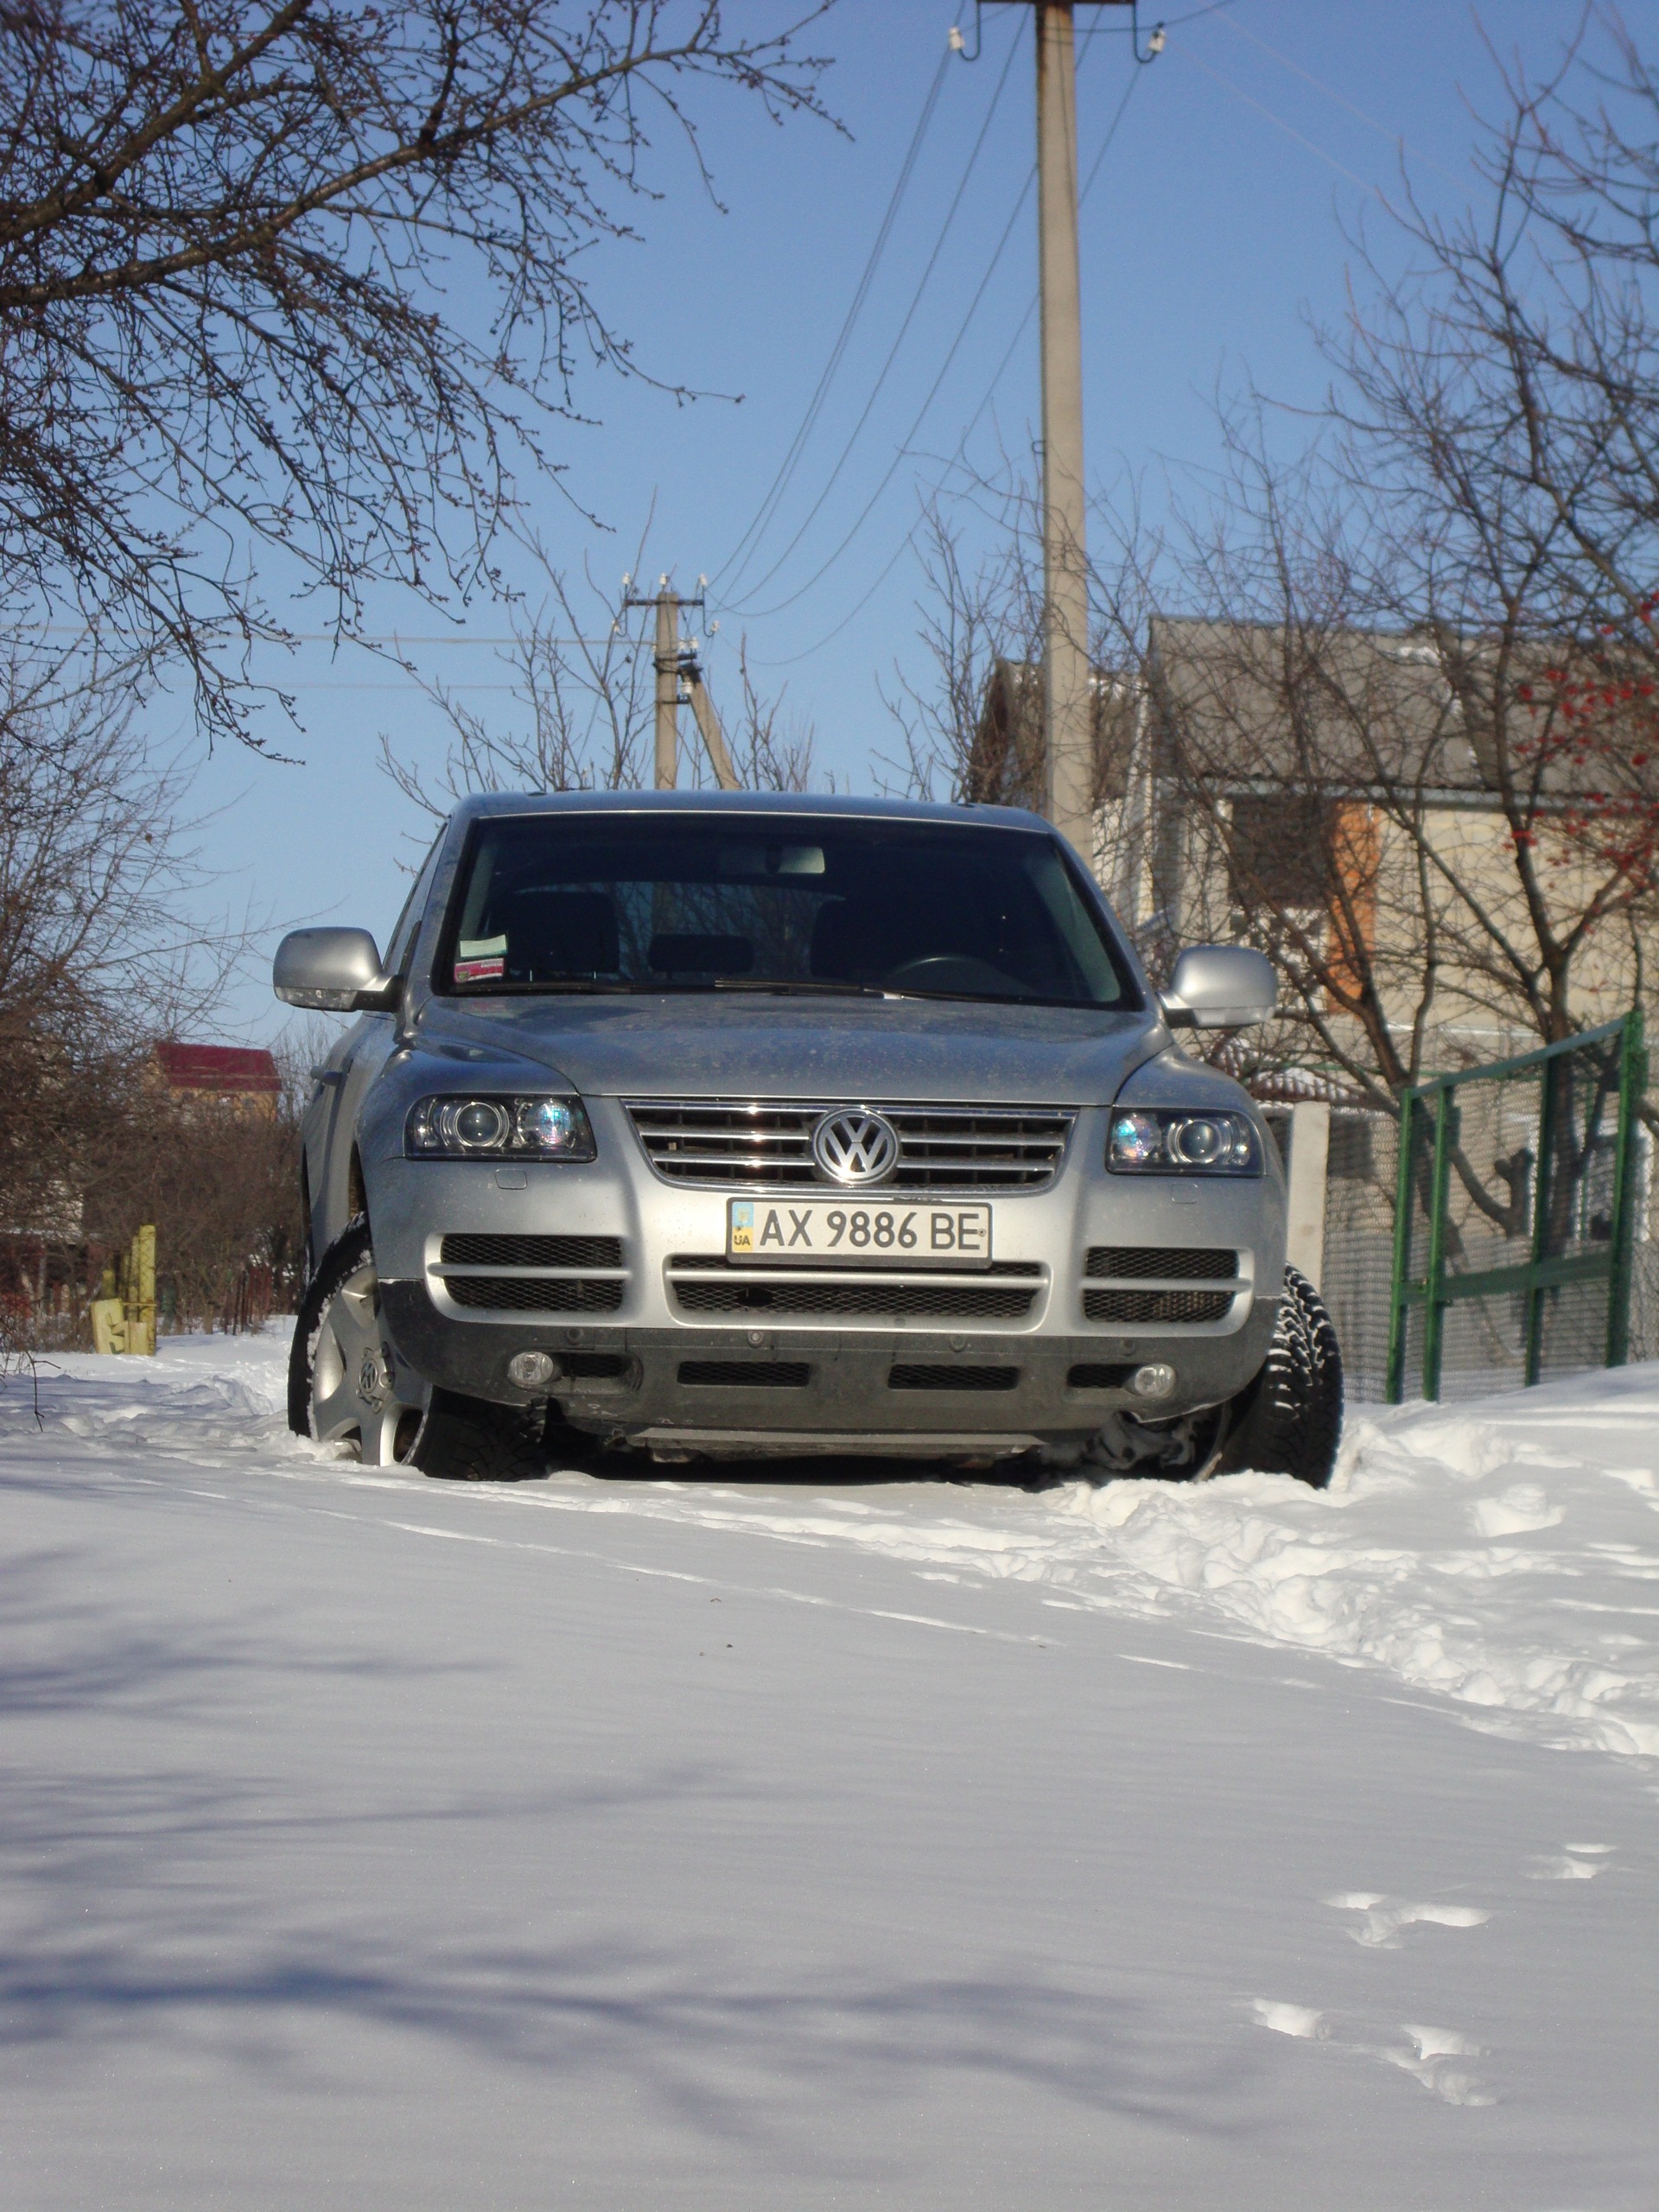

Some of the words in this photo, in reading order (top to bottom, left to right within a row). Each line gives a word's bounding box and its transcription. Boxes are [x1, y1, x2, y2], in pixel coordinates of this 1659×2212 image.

[817, 1111, 895, 1179] VW
[734, 1235, 751, 1246] UA
[760, 1209, 813, 1246] AX
[826, 1211, 918, 1248] 9886
[931, 1212, 981, 1250] BE
